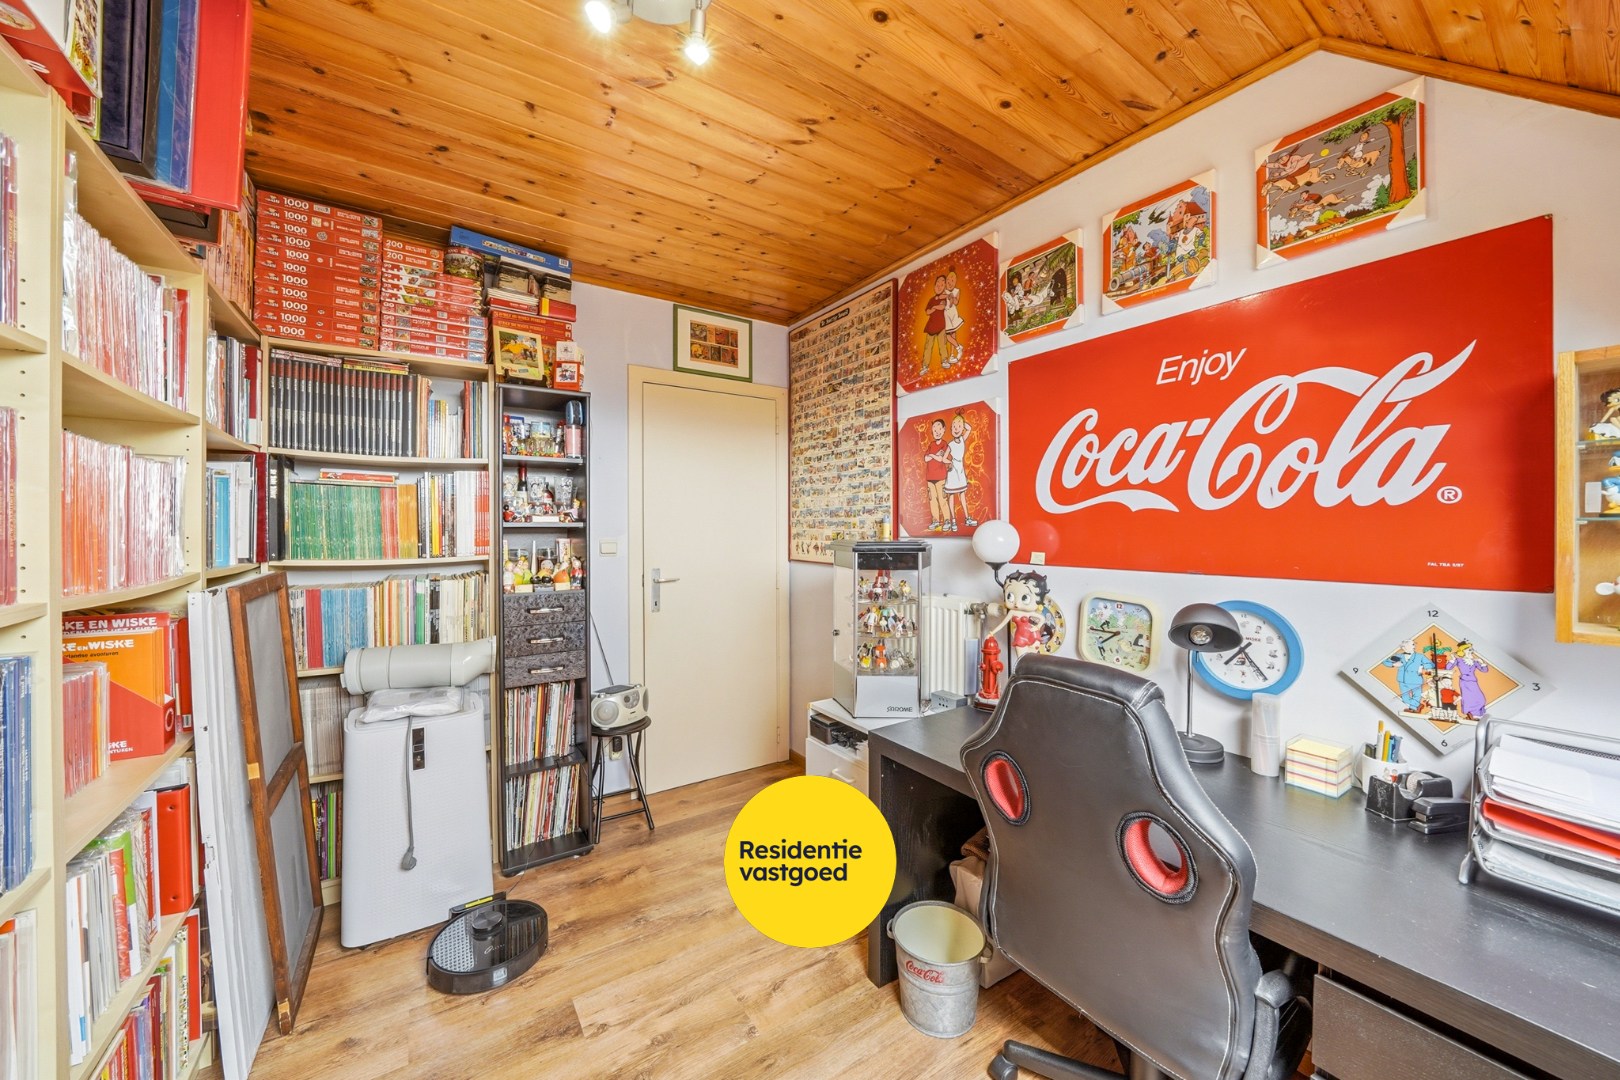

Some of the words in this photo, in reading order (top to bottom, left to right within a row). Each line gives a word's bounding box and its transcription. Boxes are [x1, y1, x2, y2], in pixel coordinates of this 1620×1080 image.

[283, 197, 309, 210] 1000
[284, 211, 308, 222] 1000
[284, 223, 307, 235] 1000
[285, 236, 310, 248] 1000
[386, 240, 403, 249] 200
[285, 249, 309, 260] 1000
[386, 252, 403, 261] 200
[283, 262, 307, 273] 1000
[282, 274, 308, 286] 1000
[281, 287, 308, 298] 1000
[282, 300, 308, 311] 1000
[280, 312, 307, 324] 1000
[279, 325, 305, 336] 1000
[1156, 347, 1248, 386] Enjoy
[1035, 339, 1477, 514] Coca-Cola
[1428, 610, 1439, 618] 12
[88, 620, 108, 629] EN
[111, 617, 157, 627] WISKE
[88, 639, 134, 650] WISKE
[1532, 682, 1541, 692] 3
